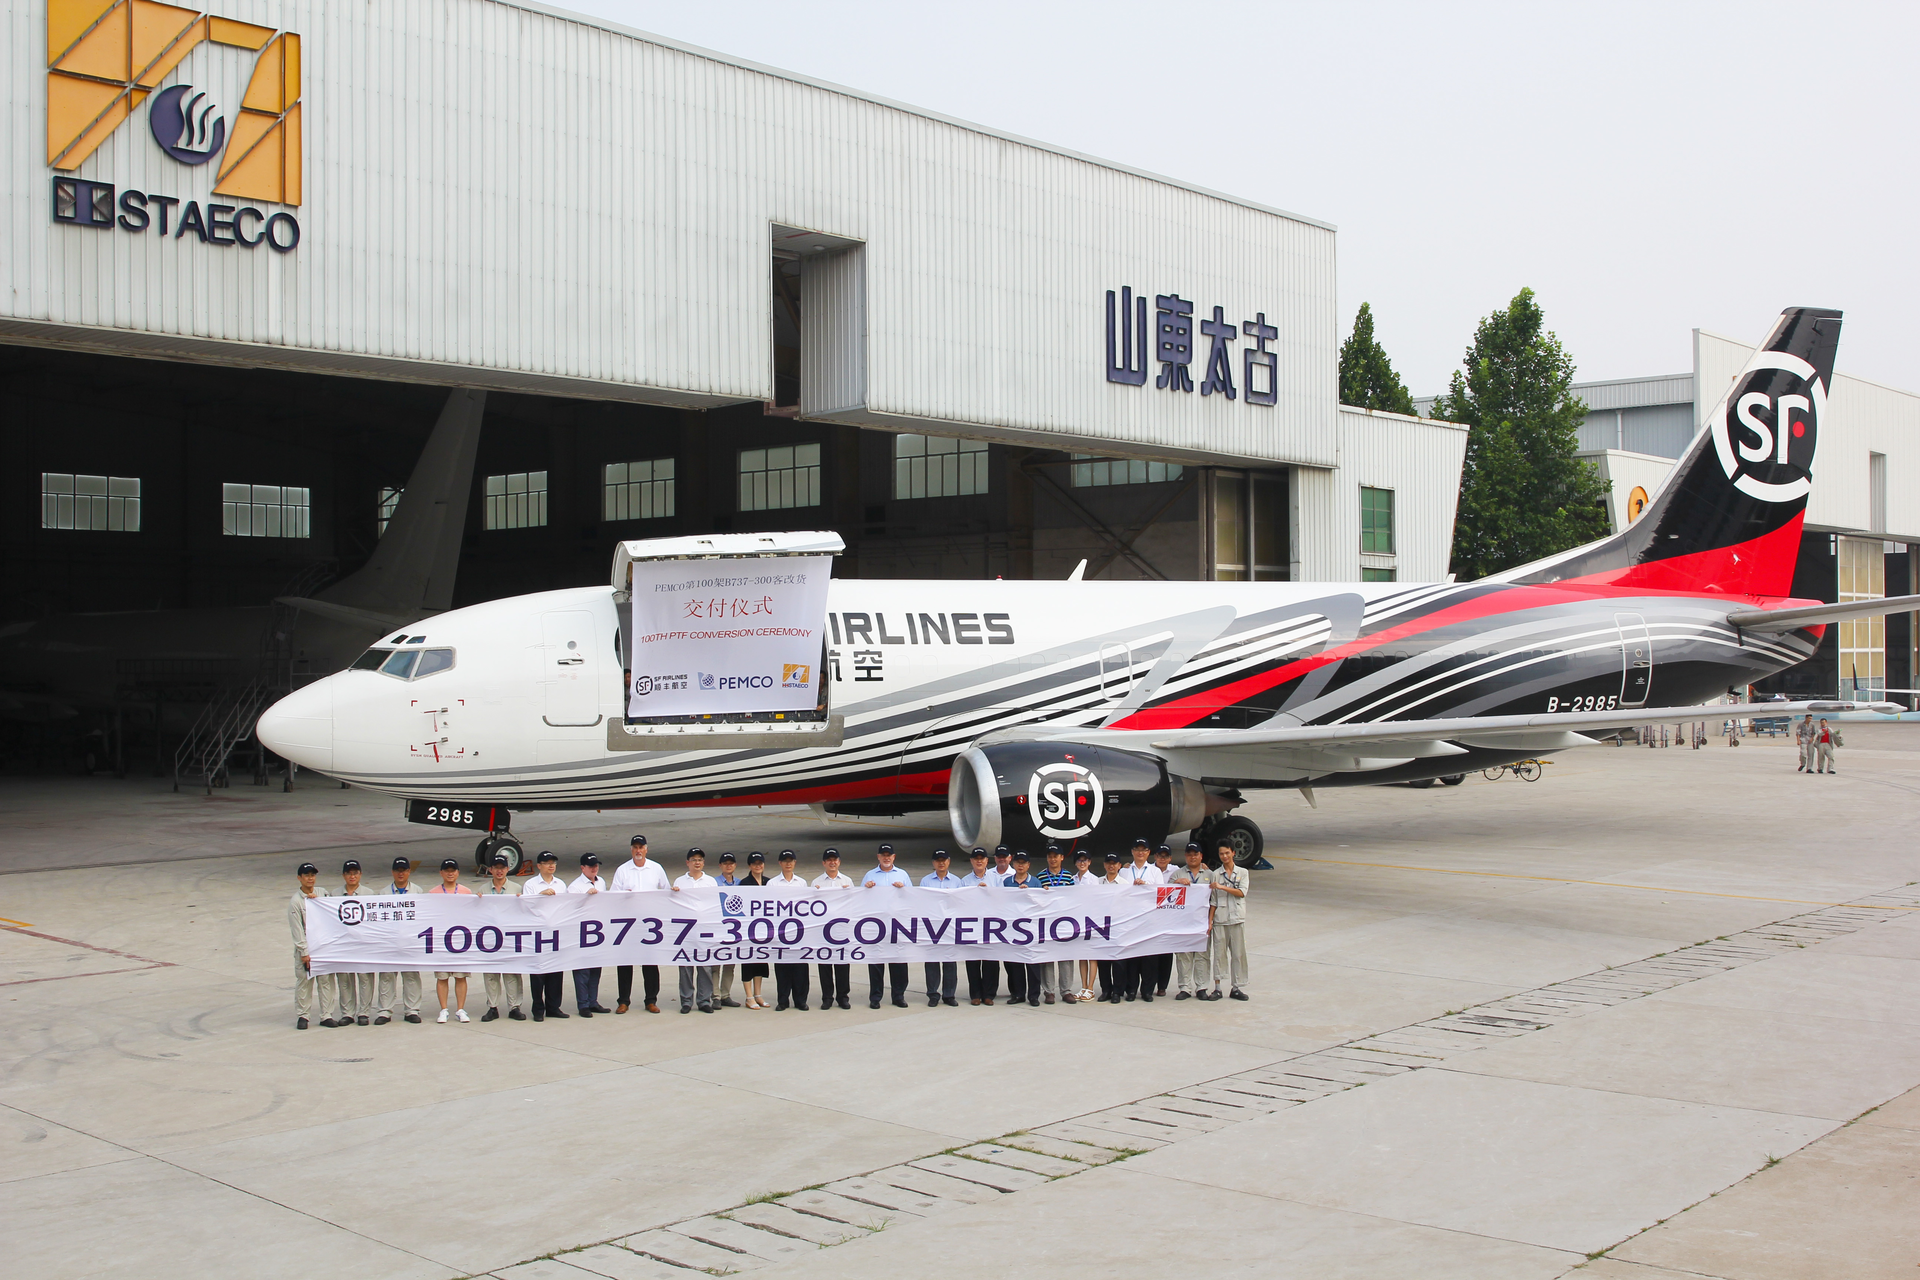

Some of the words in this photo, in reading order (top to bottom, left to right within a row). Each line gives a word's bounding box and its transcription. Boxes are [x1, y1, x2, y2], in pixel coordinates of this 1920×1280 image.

[118, 189, 301, 253] STAECO
[1106, 285, 1279, 407] 山東太古
[682, 595, 773, 619] 交付仪式
[641, 632, 668, 644] 100TH
[668, 631, 688, 640] PTF
[689, 628, 754, 640] CONVERSION
[755, 627, 812, 638] CEREMONY
[828, 612, 1015, 645] IRLINES
[654, 681, 688, 691] 顺丰航空
[719, 675, 774, 690] PEMCO
[1547, 695, 1618, 713] B-2985
[426, 806, 474, 824] 2985
[366, 902, 377, 910] SF
[379, 901, 416, 909] AIRLINES
[750, 900, 828, 917] PEMCO
[366, 910, 416, 922] 顺丰航空
[417, 924, 560, 954] 100TH
[579, 917, 805, 949] B737-300
[823, 915, 1112, 945] CONVERSION
[672, 946, 791, 962] AUGUST
[800, 946, 866, 961] 2016
